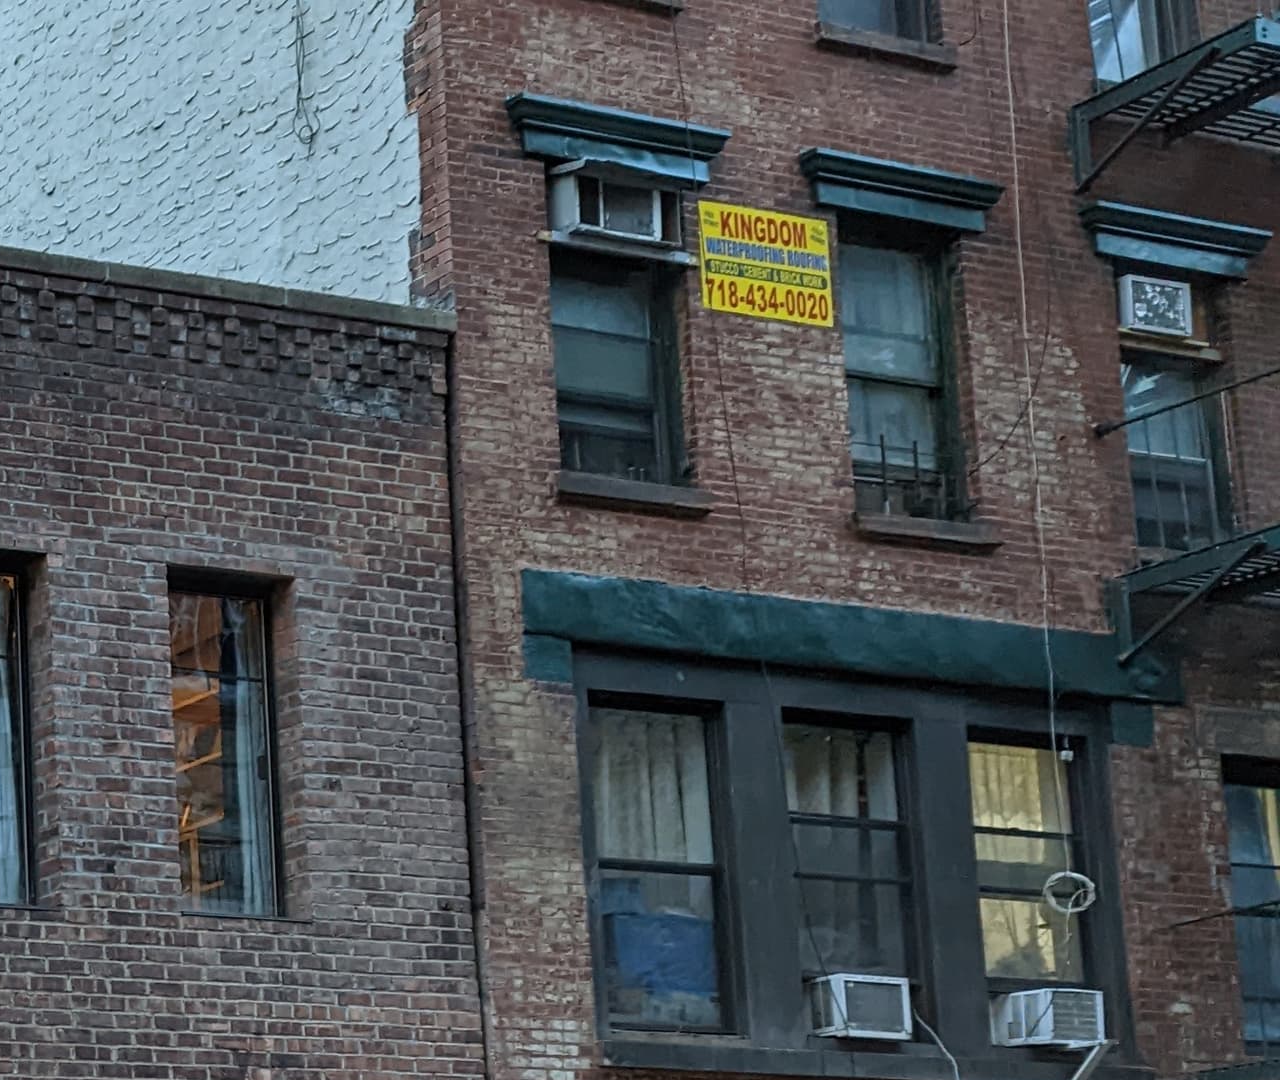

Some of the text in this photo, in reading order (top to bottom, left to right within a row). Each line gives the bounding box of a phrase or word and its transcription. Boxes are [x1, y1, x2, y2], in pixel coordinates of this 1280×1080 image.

[720, 211, 807, 248] KINGDOM
[706, 238, 828, 272] WATERPROOFING ROOFING
[710, 261, 739, 276] STUCCO
[705, 278, 828, 320] 718-434-0020
